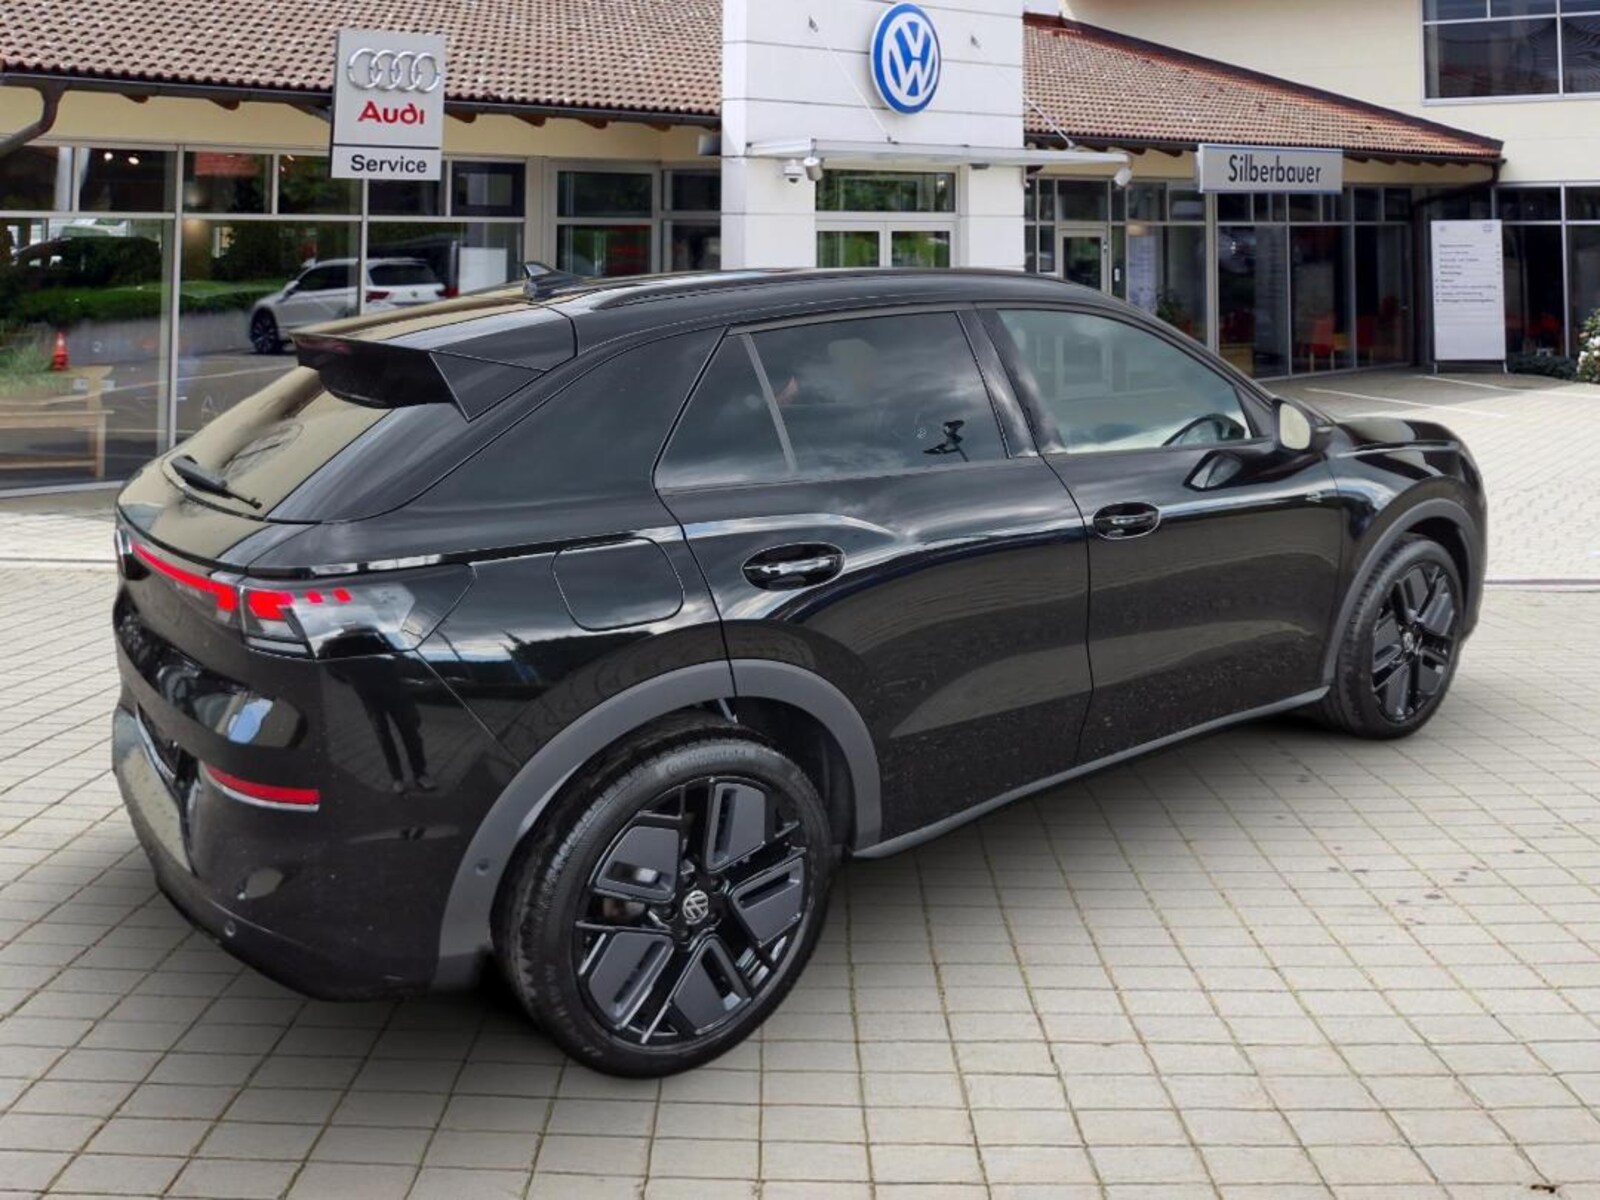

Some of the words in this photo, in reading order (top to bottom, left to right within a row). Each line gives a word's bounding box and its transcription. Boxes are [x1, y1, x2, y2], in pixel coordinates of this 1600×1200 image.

[358, 100, 425, 125] Audi
[350, 154, 427, 173] Service
[1228, 153, 1321, 183] Silberbauer
